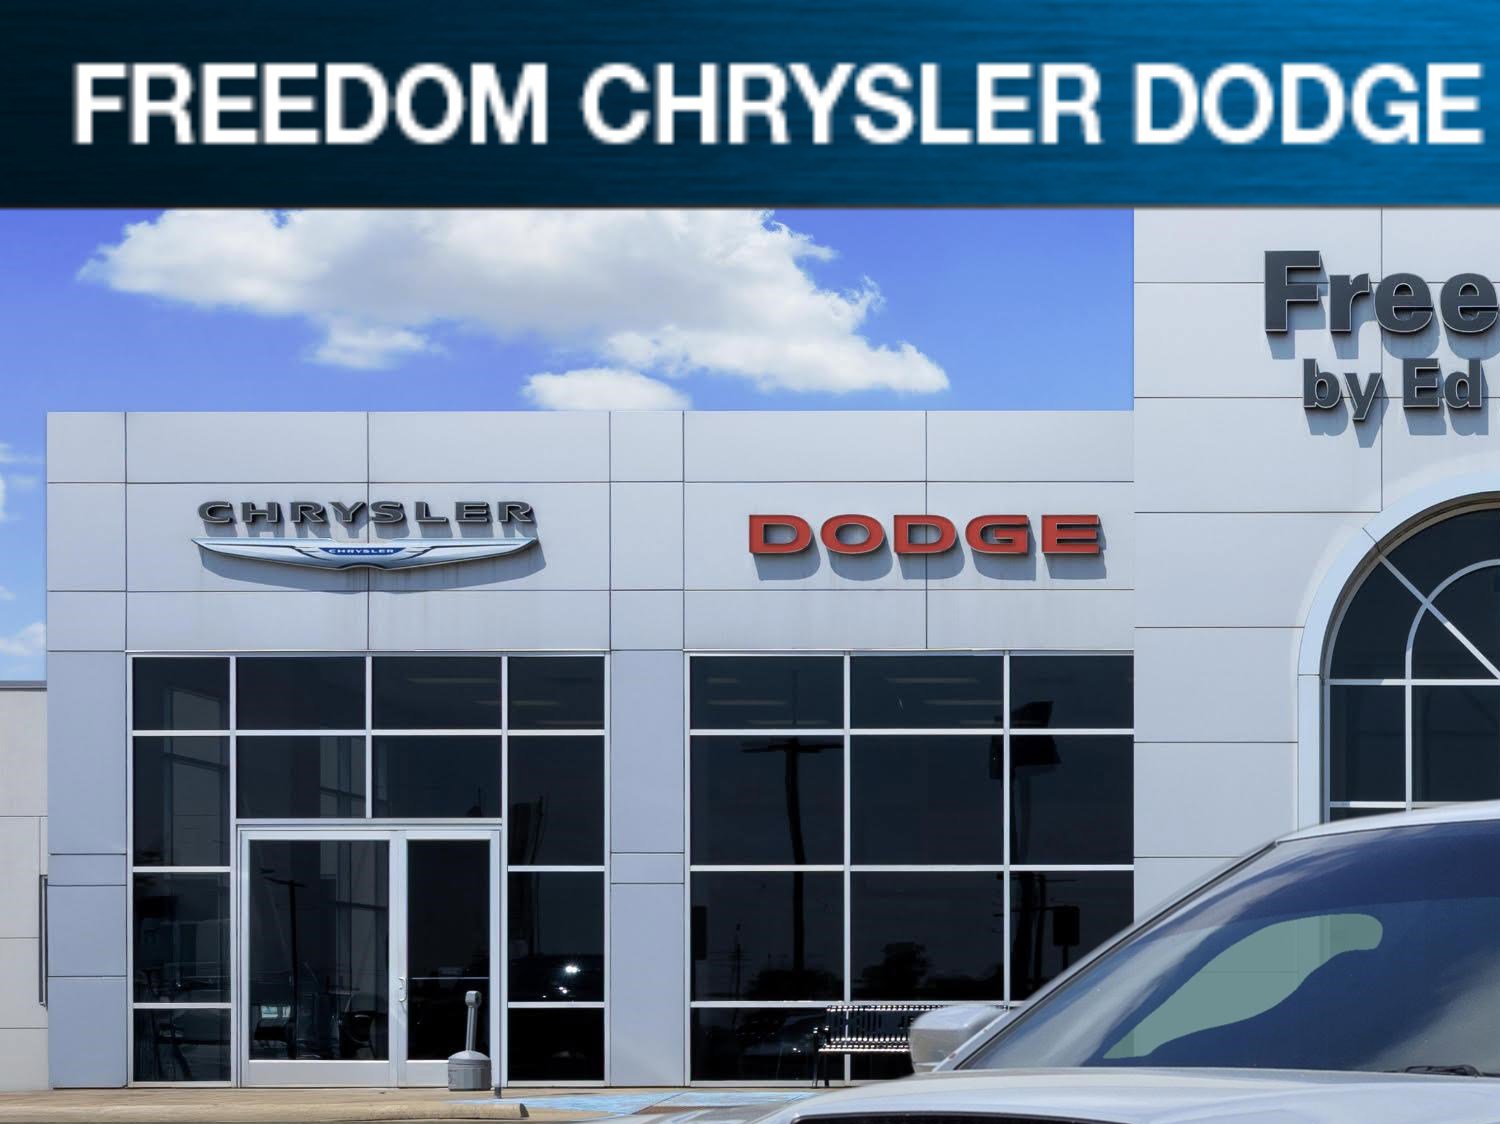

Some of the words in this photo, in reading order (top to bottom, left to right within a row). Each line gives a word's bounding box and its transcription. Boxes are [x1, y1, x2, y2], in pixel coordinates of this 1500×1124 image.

[1302, 358, 1382, 421] by
[1402, 358, 1482, 410] Ed
[197, 500, 536, 524] CHRYSLER
[749, 514, 1101, 555] DODGE
